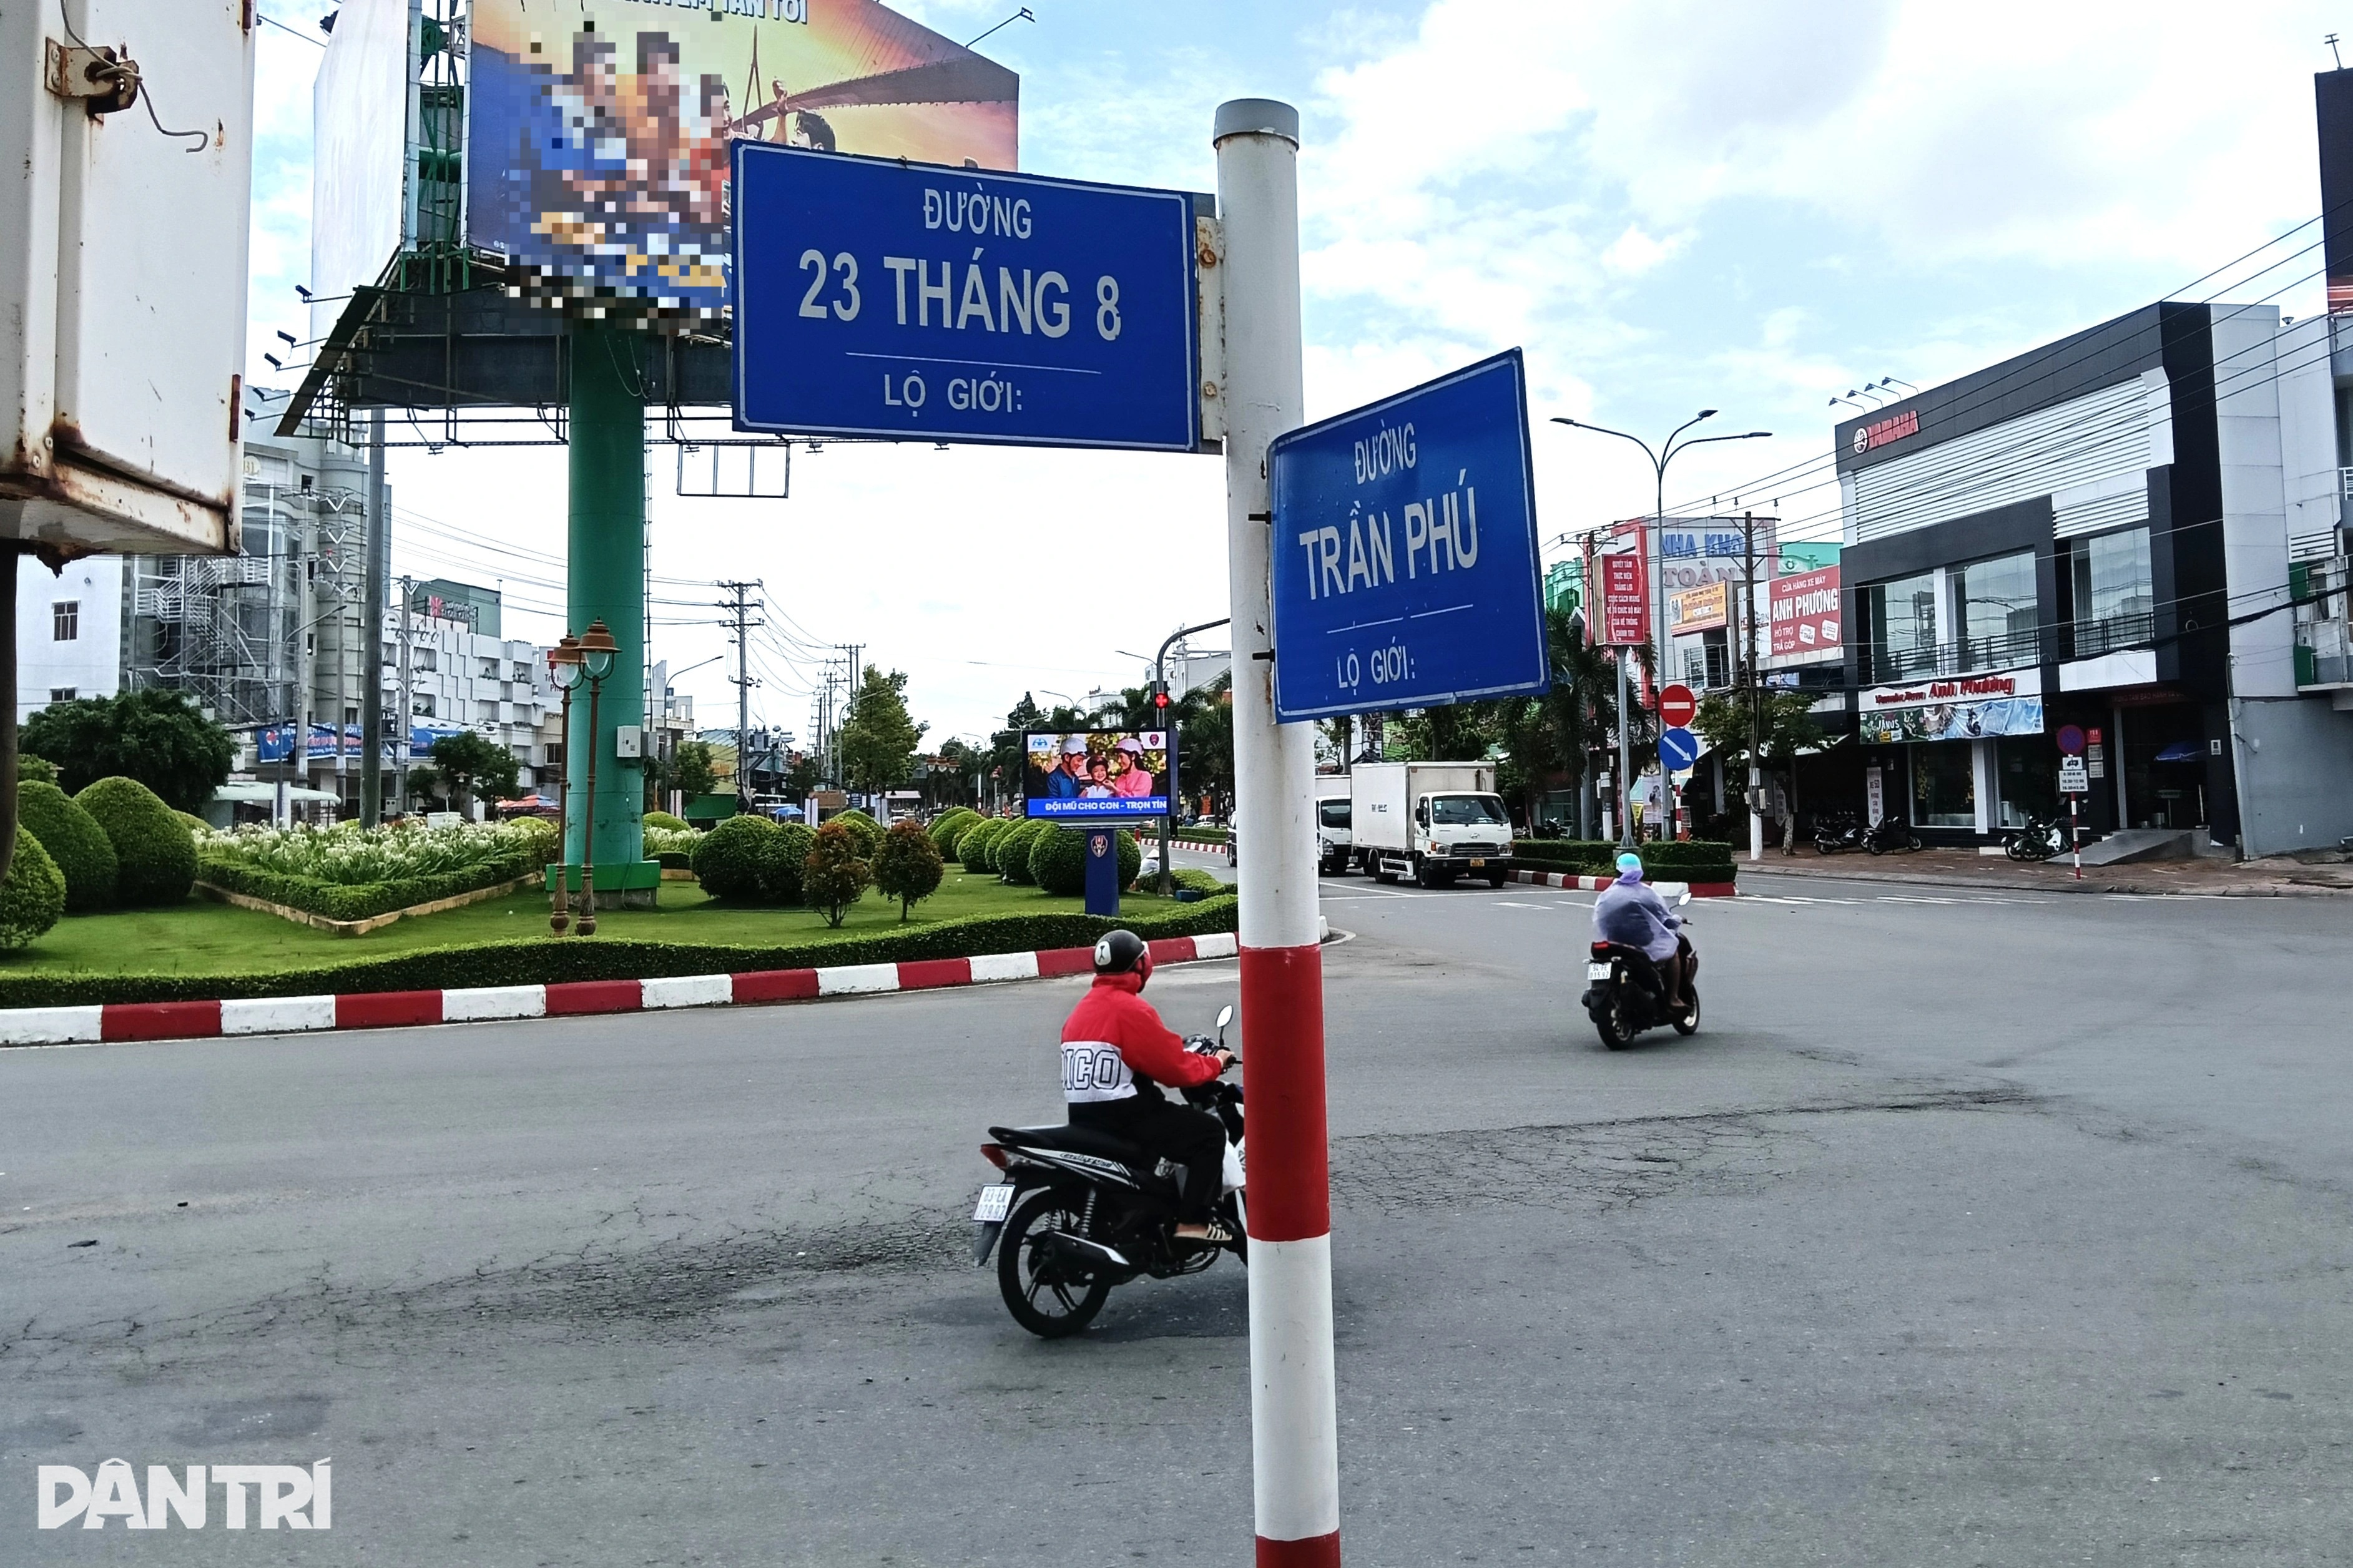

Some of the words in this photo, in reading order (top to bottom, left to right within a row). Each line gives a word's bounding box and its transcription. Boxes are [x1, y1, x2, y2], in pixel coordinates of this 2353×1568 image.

[923, 182, 1032, 239] ĐƯỜNG
[798, 249, 860, 321] 23
[883, 247, 1070, 338] THÁNG
[1096, 275, 1121, 341] 8
[884, 370, 926, 417] LỘ
[947, 371, 1023, 413] GIỚI:
[1355, 419, 1417, 485] ĐƯỜNG
[1299, 500, 1394, 600] TRẦN
[1404, 468, 1478, 579] PHÚ
[1661, 534, 1697, 557] NHA
[1705, 534, 1756, 557] KHO
[1792, 580, 1807, 590] HÀNG
[1807, 578, 1814, 587] XE
[1814, 574, 1826, 585] MÁY
[1772, 597, 1793, 622] ANH
[1795, 588, 1839, 617] PHƯƠNG
[1784, 638, 1795, 650] GÓP
[1337, 648, 1360, 696] LỘ
[1370, 636, 1415, 684] GIỚI:
[1928, 682, 1958, 699] Anh
[1876, 719, 1900, 732] JANUS
[1045, 801, 1061, 812] ĐỘI
[1063, 800, 1077, 810] MŨ
[1078, 801, 1098, 810] CHO
[1099, 801, 1119, 810] CON
[1126, 801, 1151, 811] TRỌN
[1062, 1049, 1121, 1090] ICO
